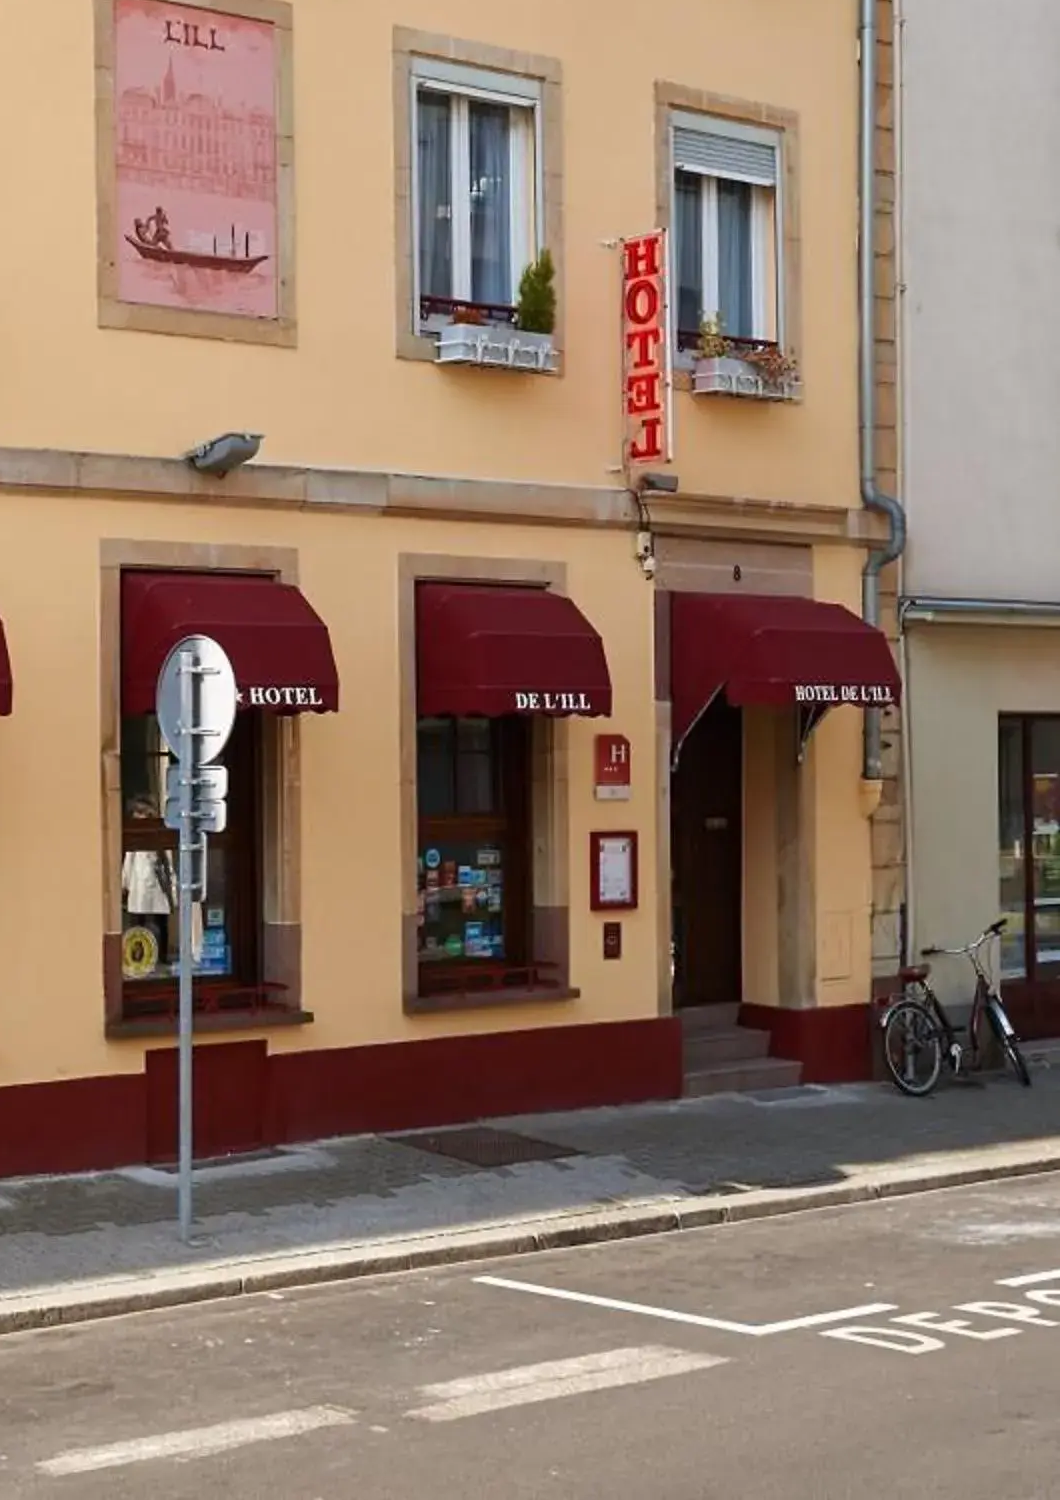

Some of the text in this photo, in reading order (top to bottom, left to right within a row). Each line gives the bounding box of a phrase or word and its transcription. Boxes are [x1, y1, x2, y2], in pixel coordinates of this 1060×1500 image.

[164, 20, 225, 51] L'ILL
[733, 564, 741, 581] 8
[250, 687, 323, 704] HOTEL
[516, 692, 591, 709] DE L'ILL
[795, 685, 894, 701] HOTEL DE L'ILL
[611, 744, 625, 763] H
[818, 1289, 1060, 1355] DEP
